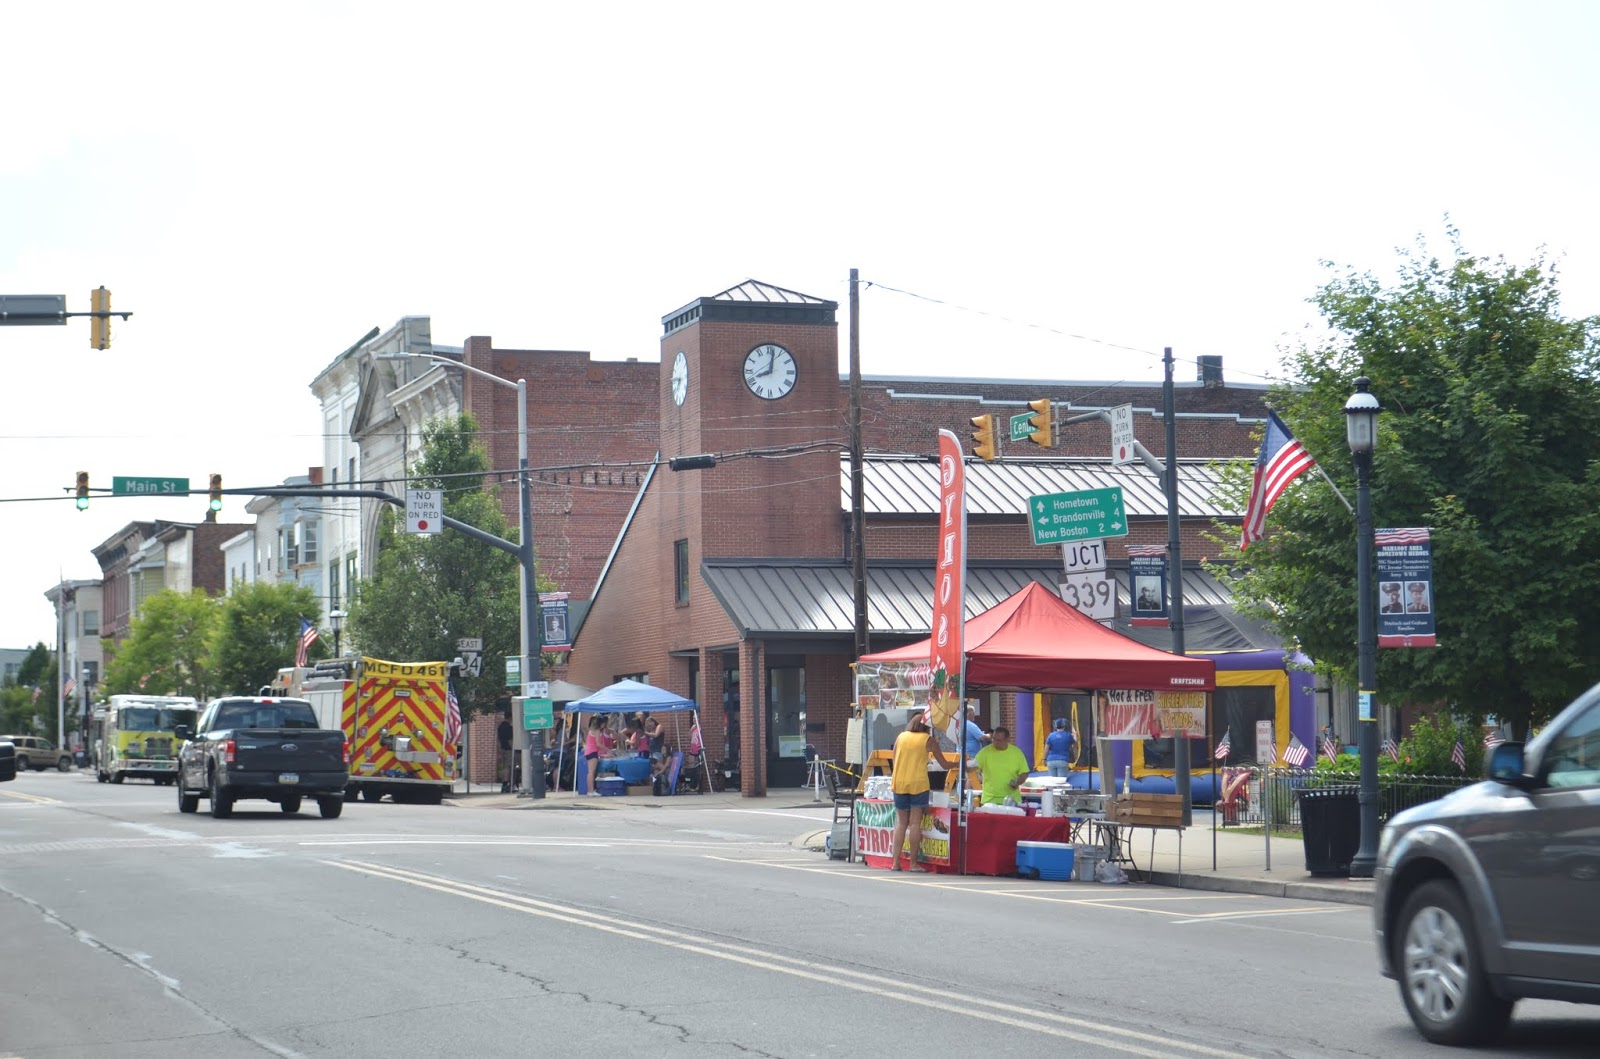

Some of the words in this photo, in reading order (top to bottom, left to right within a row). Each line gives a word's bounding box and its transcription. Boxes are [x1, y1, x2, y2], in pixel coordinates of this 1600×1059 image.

[1116, 408, 1126, 419] NO
[1116, 422, 1129, 433] TURN
[1114, 436, 1120, 445] ON
[1122, 433, 1131, 443] RED
[126, 480, 158, 493] Main
[162, 481, 176, 493] St
[416, 491, 431, 500] NO
[1053, 497, 1099, 510] Hometown
[1112, 493, 1118, 503] 9
[413, 502, 435, 510] TURN
[408, 511, 420, 519] ON
[423, 511, 439, 519] RED
[1053, 510, 1105, 524] Brandonville
[1114, 507, 1120, 517] 4
[1038, 530, 1057, 540] New
[1060, 526, 1089, 537] Boston
[1098, 523, 1105, 533] 2
[1069, 544, 1100, 567] JCT
[1065, 580, 1110, 609] 339
[461, 640, 478, 649] EAST
[364, 661, 414, 676] MCFD
[417, 665, 445, 677] 461
[1170, 677, 1205, 685] CRAFTSMAN
[1109, 689, 1125, 702] Hot
